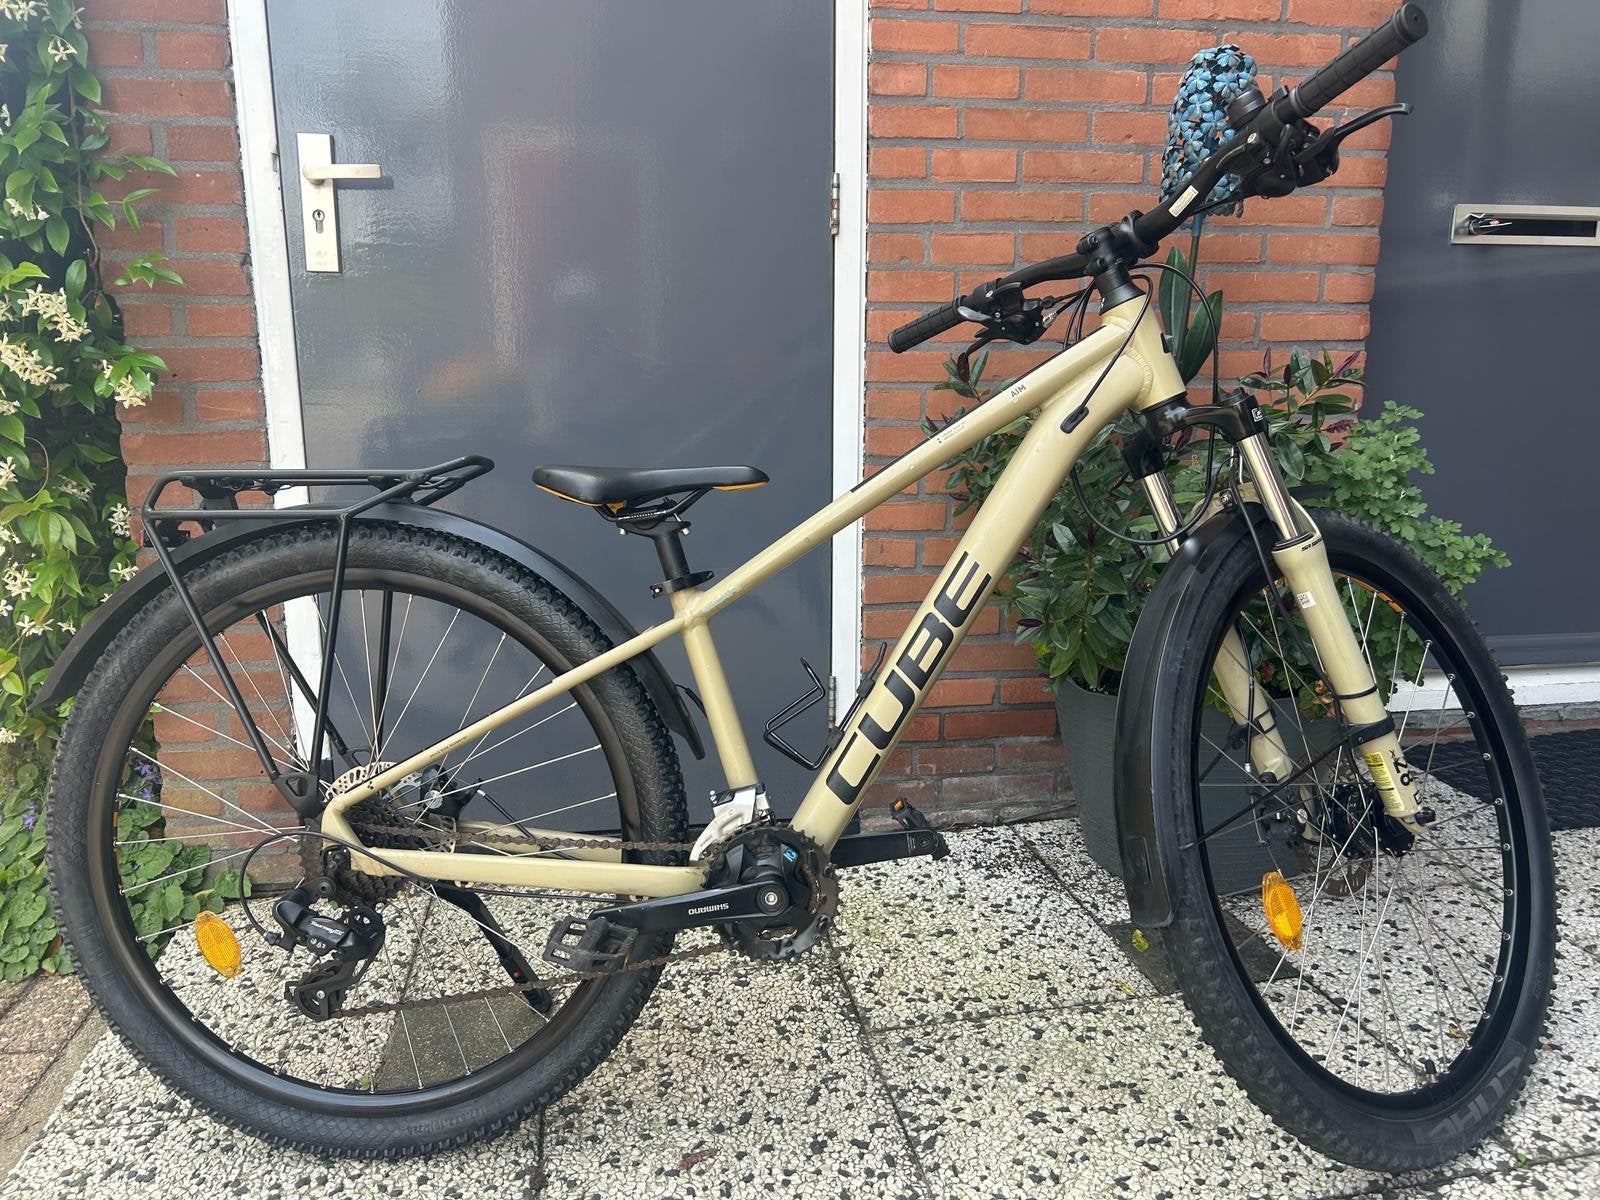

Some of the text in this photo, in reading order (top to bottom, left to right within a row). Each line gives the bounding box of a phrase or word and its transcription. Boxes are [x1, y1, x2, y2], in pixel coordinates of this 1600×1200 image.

[1009, 383, 1027, 399] AIM
[826, 551, 992, 805] CUBE
[688, 902, 729, 915] SHIMANO
